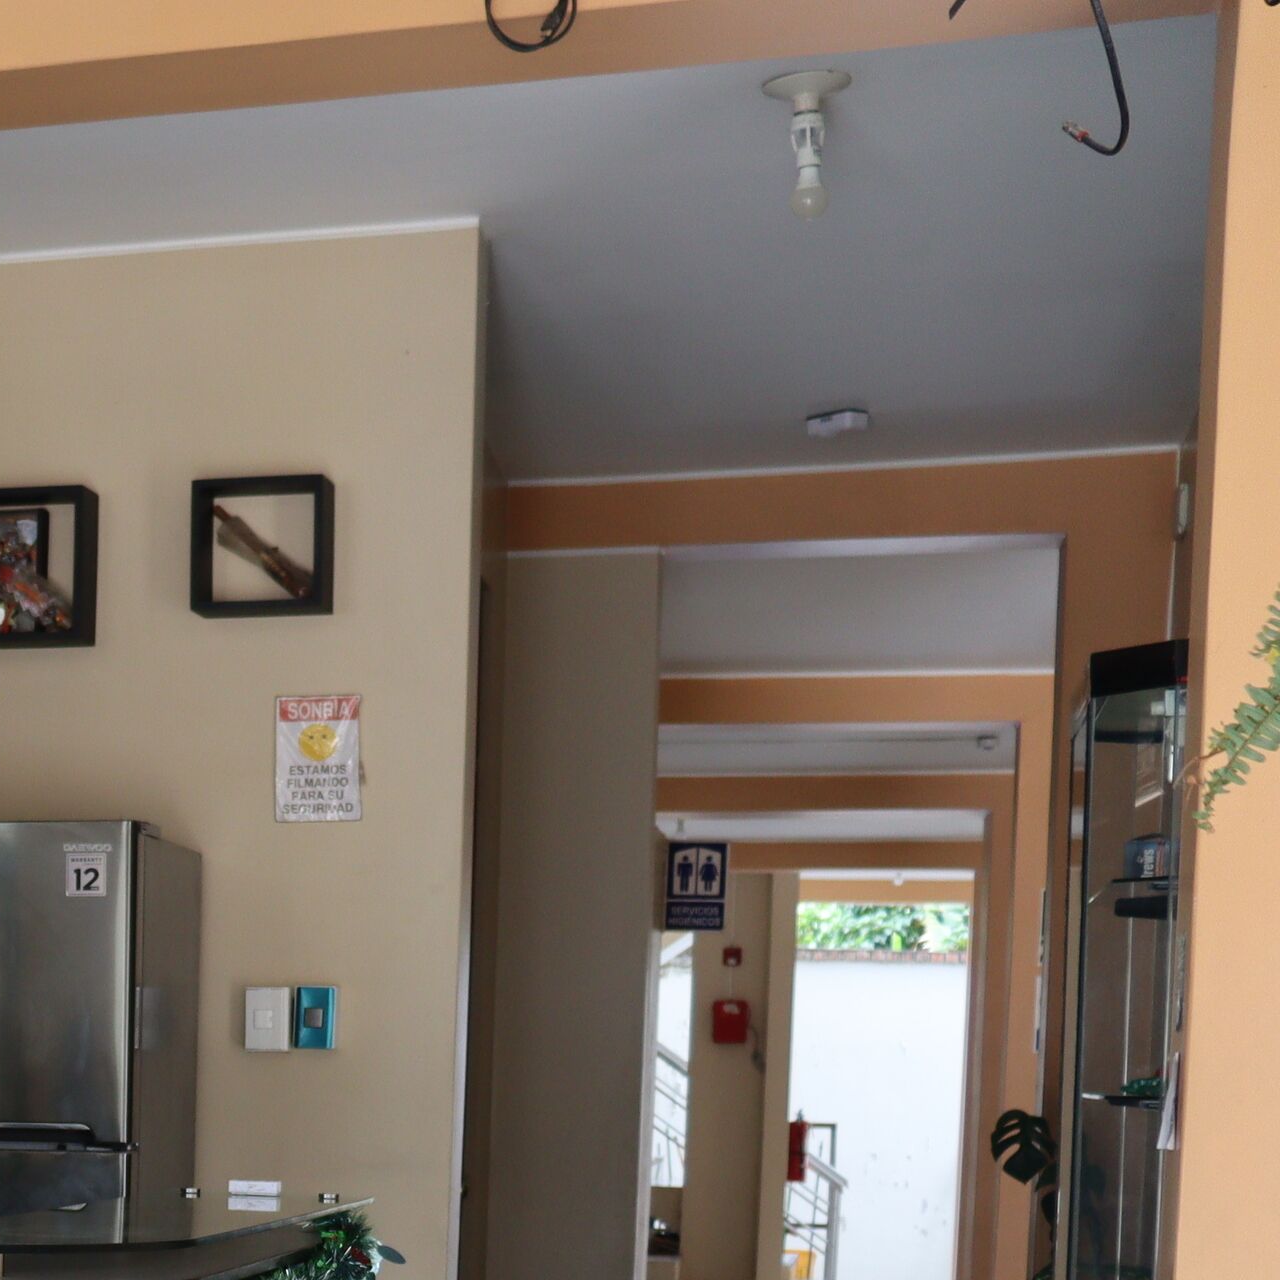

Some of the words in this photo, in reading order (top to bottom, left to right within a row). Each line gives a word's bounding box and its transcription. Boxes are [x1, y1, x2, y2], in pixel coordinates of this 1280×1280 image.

[289, 764, 347, 776] ESTAMOS
[287, 777, 349, 788] FILMANDO
[291, 790, 324, 801] PARA
[328, 789, 345, 801] SU
[73, 867, 100, 891] 12
